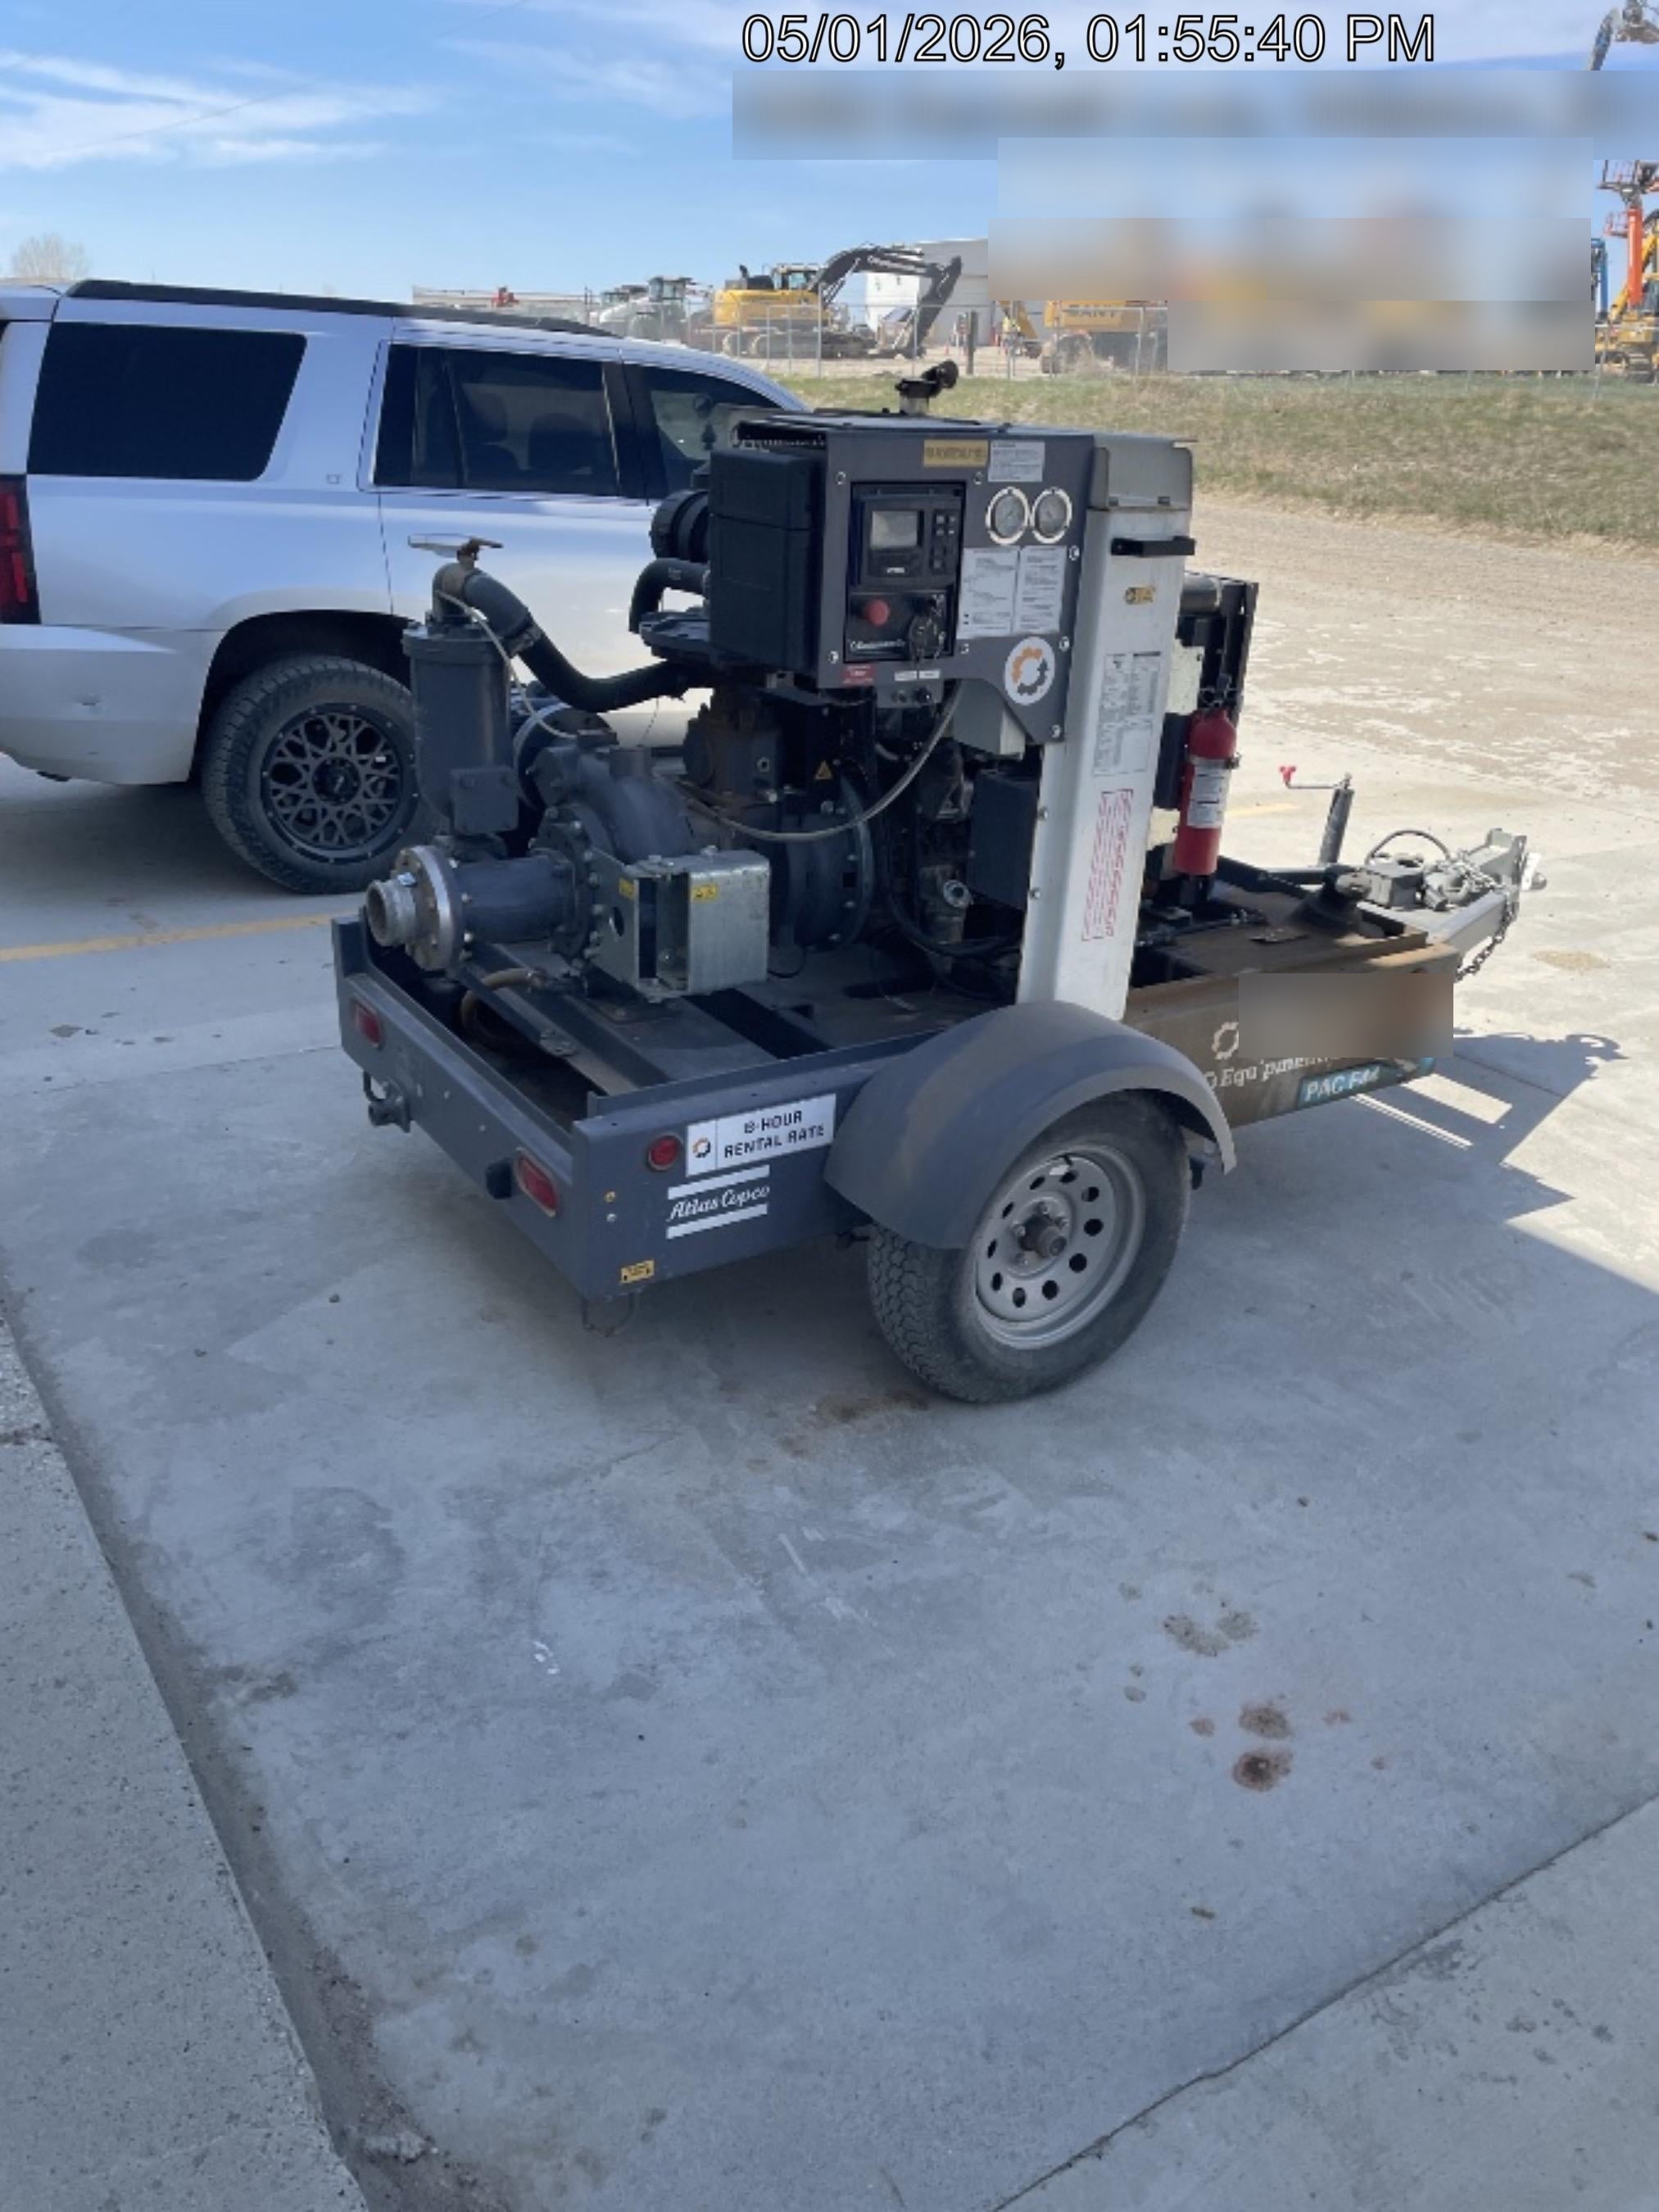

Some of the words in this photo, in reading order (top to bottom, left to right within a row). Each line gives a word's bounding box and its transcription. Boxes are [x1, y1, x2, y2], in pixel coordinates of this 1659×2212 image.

[744, 1110, 803, 1134] 8-HOUR
[724, 1136, 782, 1158] RENTAL
[787, 1125, 825, 1144] RATE
[665, 1198, 718, 1222] Atlas
[721, 1185, 771, 1208] Copco
